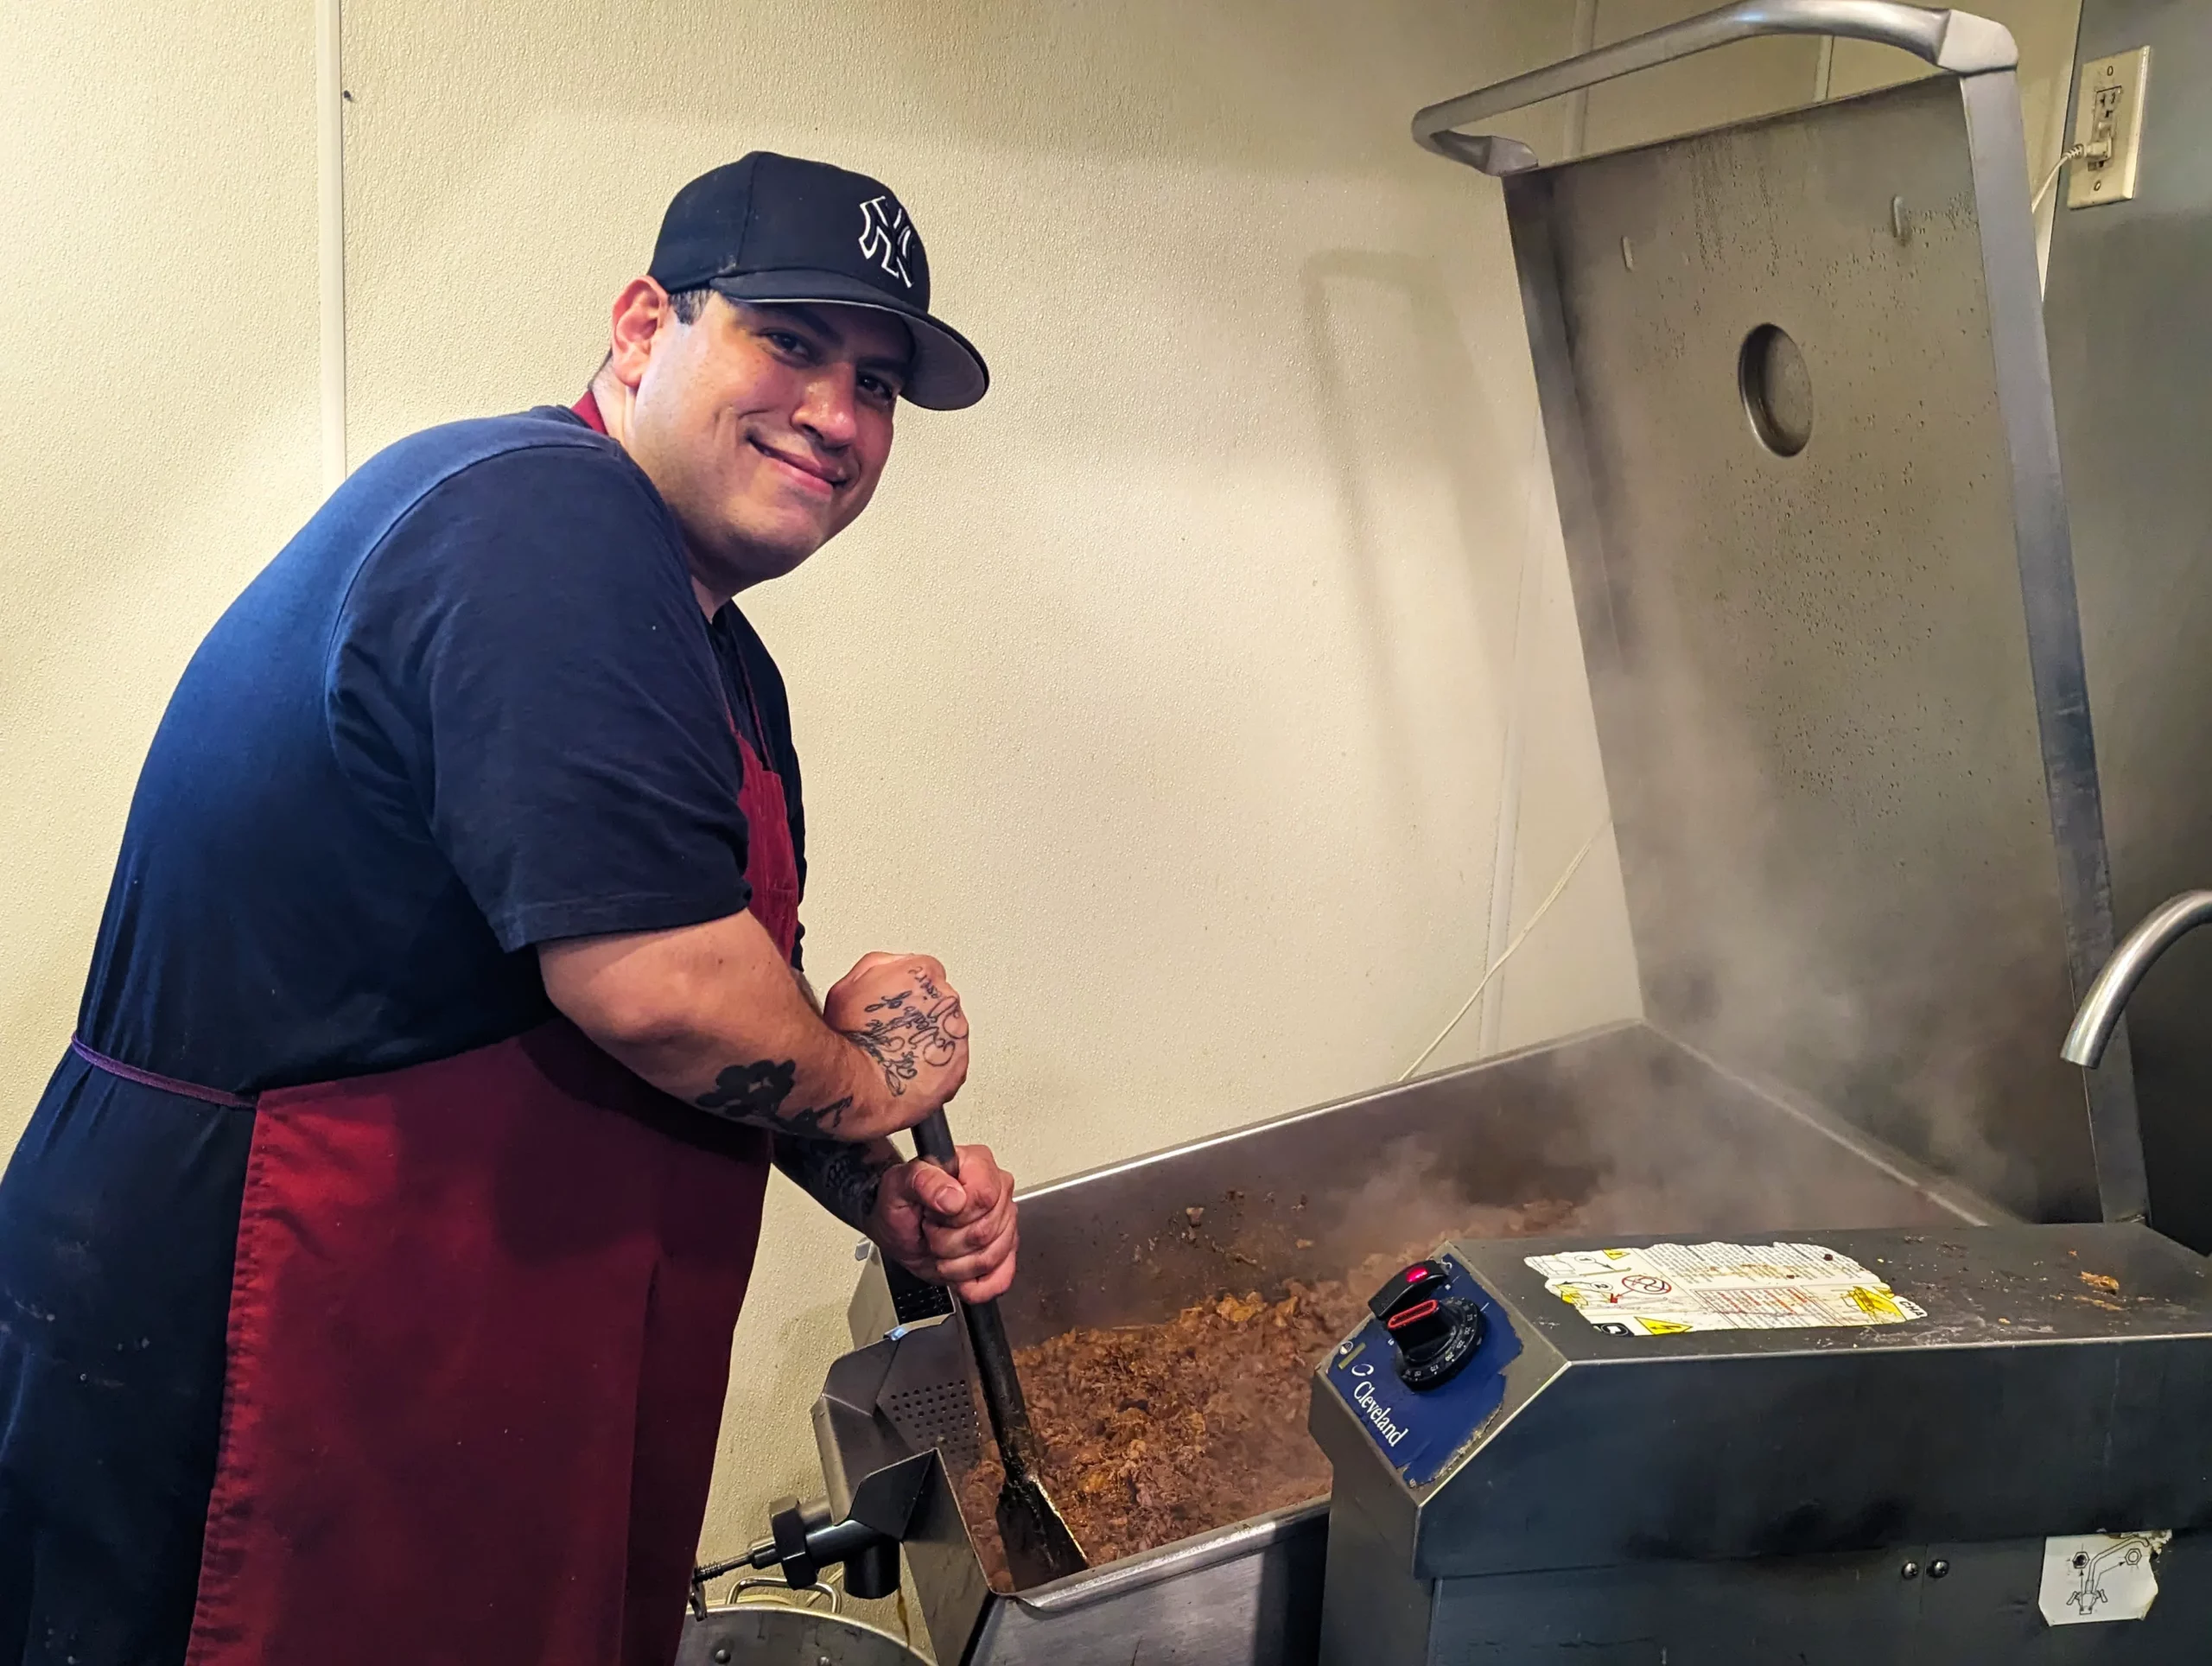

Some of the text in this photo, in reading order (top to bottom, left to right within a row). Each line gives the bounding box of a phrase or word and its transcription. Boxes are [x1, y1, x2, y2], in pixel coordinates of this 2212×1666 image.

[858, 195, 913, 289] NY
[865, 990, 912, 1013] of
[1353, 1381, 1409, 1447] Cleveland
